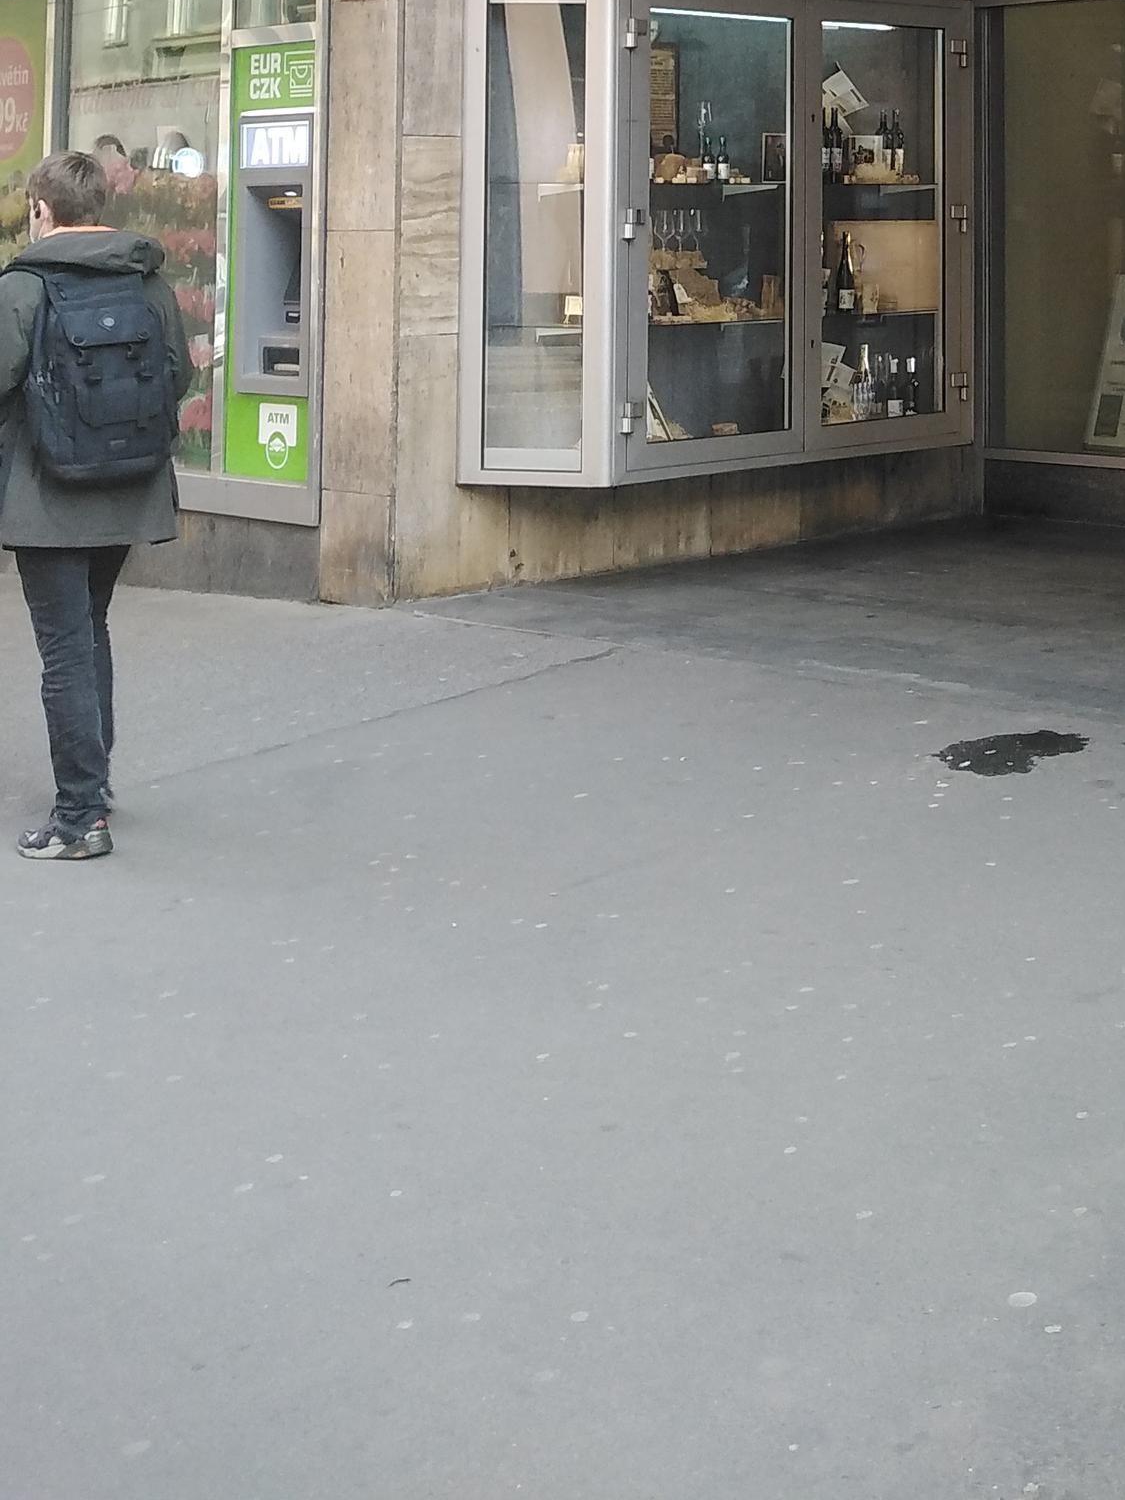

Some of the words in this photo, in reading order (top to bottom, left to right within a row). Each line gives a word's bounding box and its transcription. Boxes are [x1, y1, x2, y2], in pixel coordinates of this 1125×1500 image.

[250, 52, 281, 76] EUR
[250, 77, 281, 100] CZK
[250, 125, 307, 166] ATM
[267, 412, 290, 425] ATM
